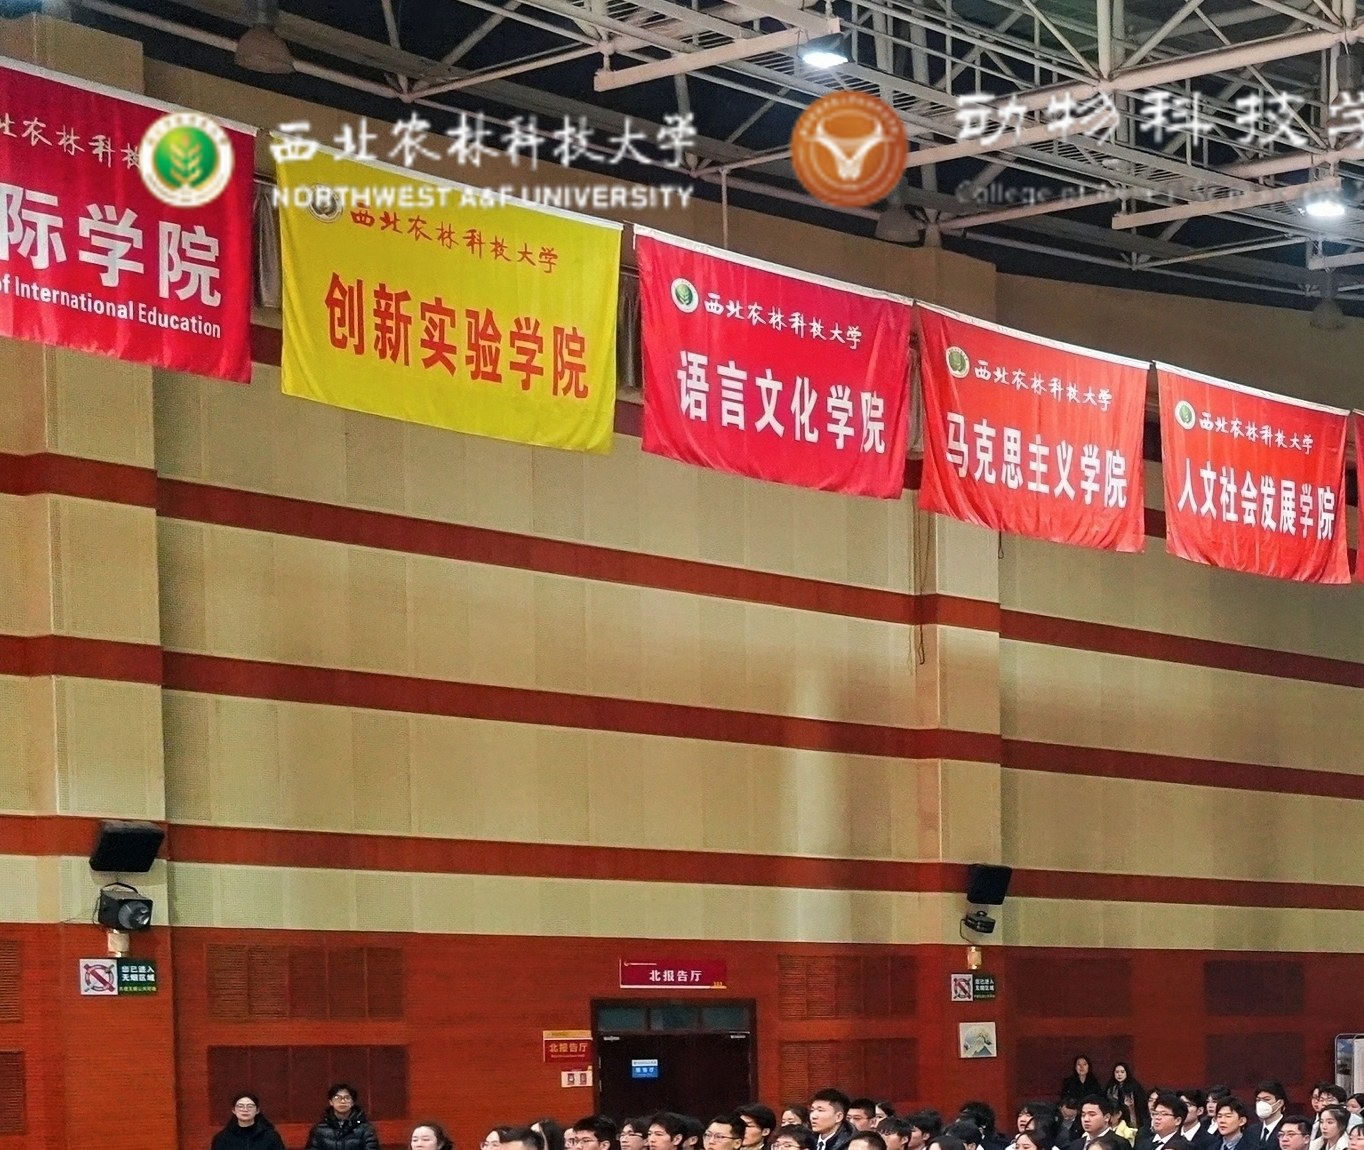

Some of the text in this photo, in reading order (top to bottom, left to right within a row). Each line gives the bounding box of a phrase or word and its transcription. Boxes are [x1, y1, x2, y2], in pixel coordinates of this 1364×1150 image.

[350, 205, 560, 274] 西北农林科技大学
[15, 276, 134, 321] International
[138, 303, 221, 339] Education
[325, 270, 590, 400] 创新实验学院
[703, 291, 863, 351] 西北农林科技大学
[676, 349, 887, 456] 语言文化学院
[974, 358, 1113, 413] 西北农林科技大学
[945, 414, 1128, 510] 马克思主义学院
[1199, 413, 1314, 455] 西北农林科技大学
[1177, 463, 1336, 542] 人文社会发展学院
[649, 969, 702, 982] 北报告厅
[549, 1042, 588, 1053] 北报告厅
